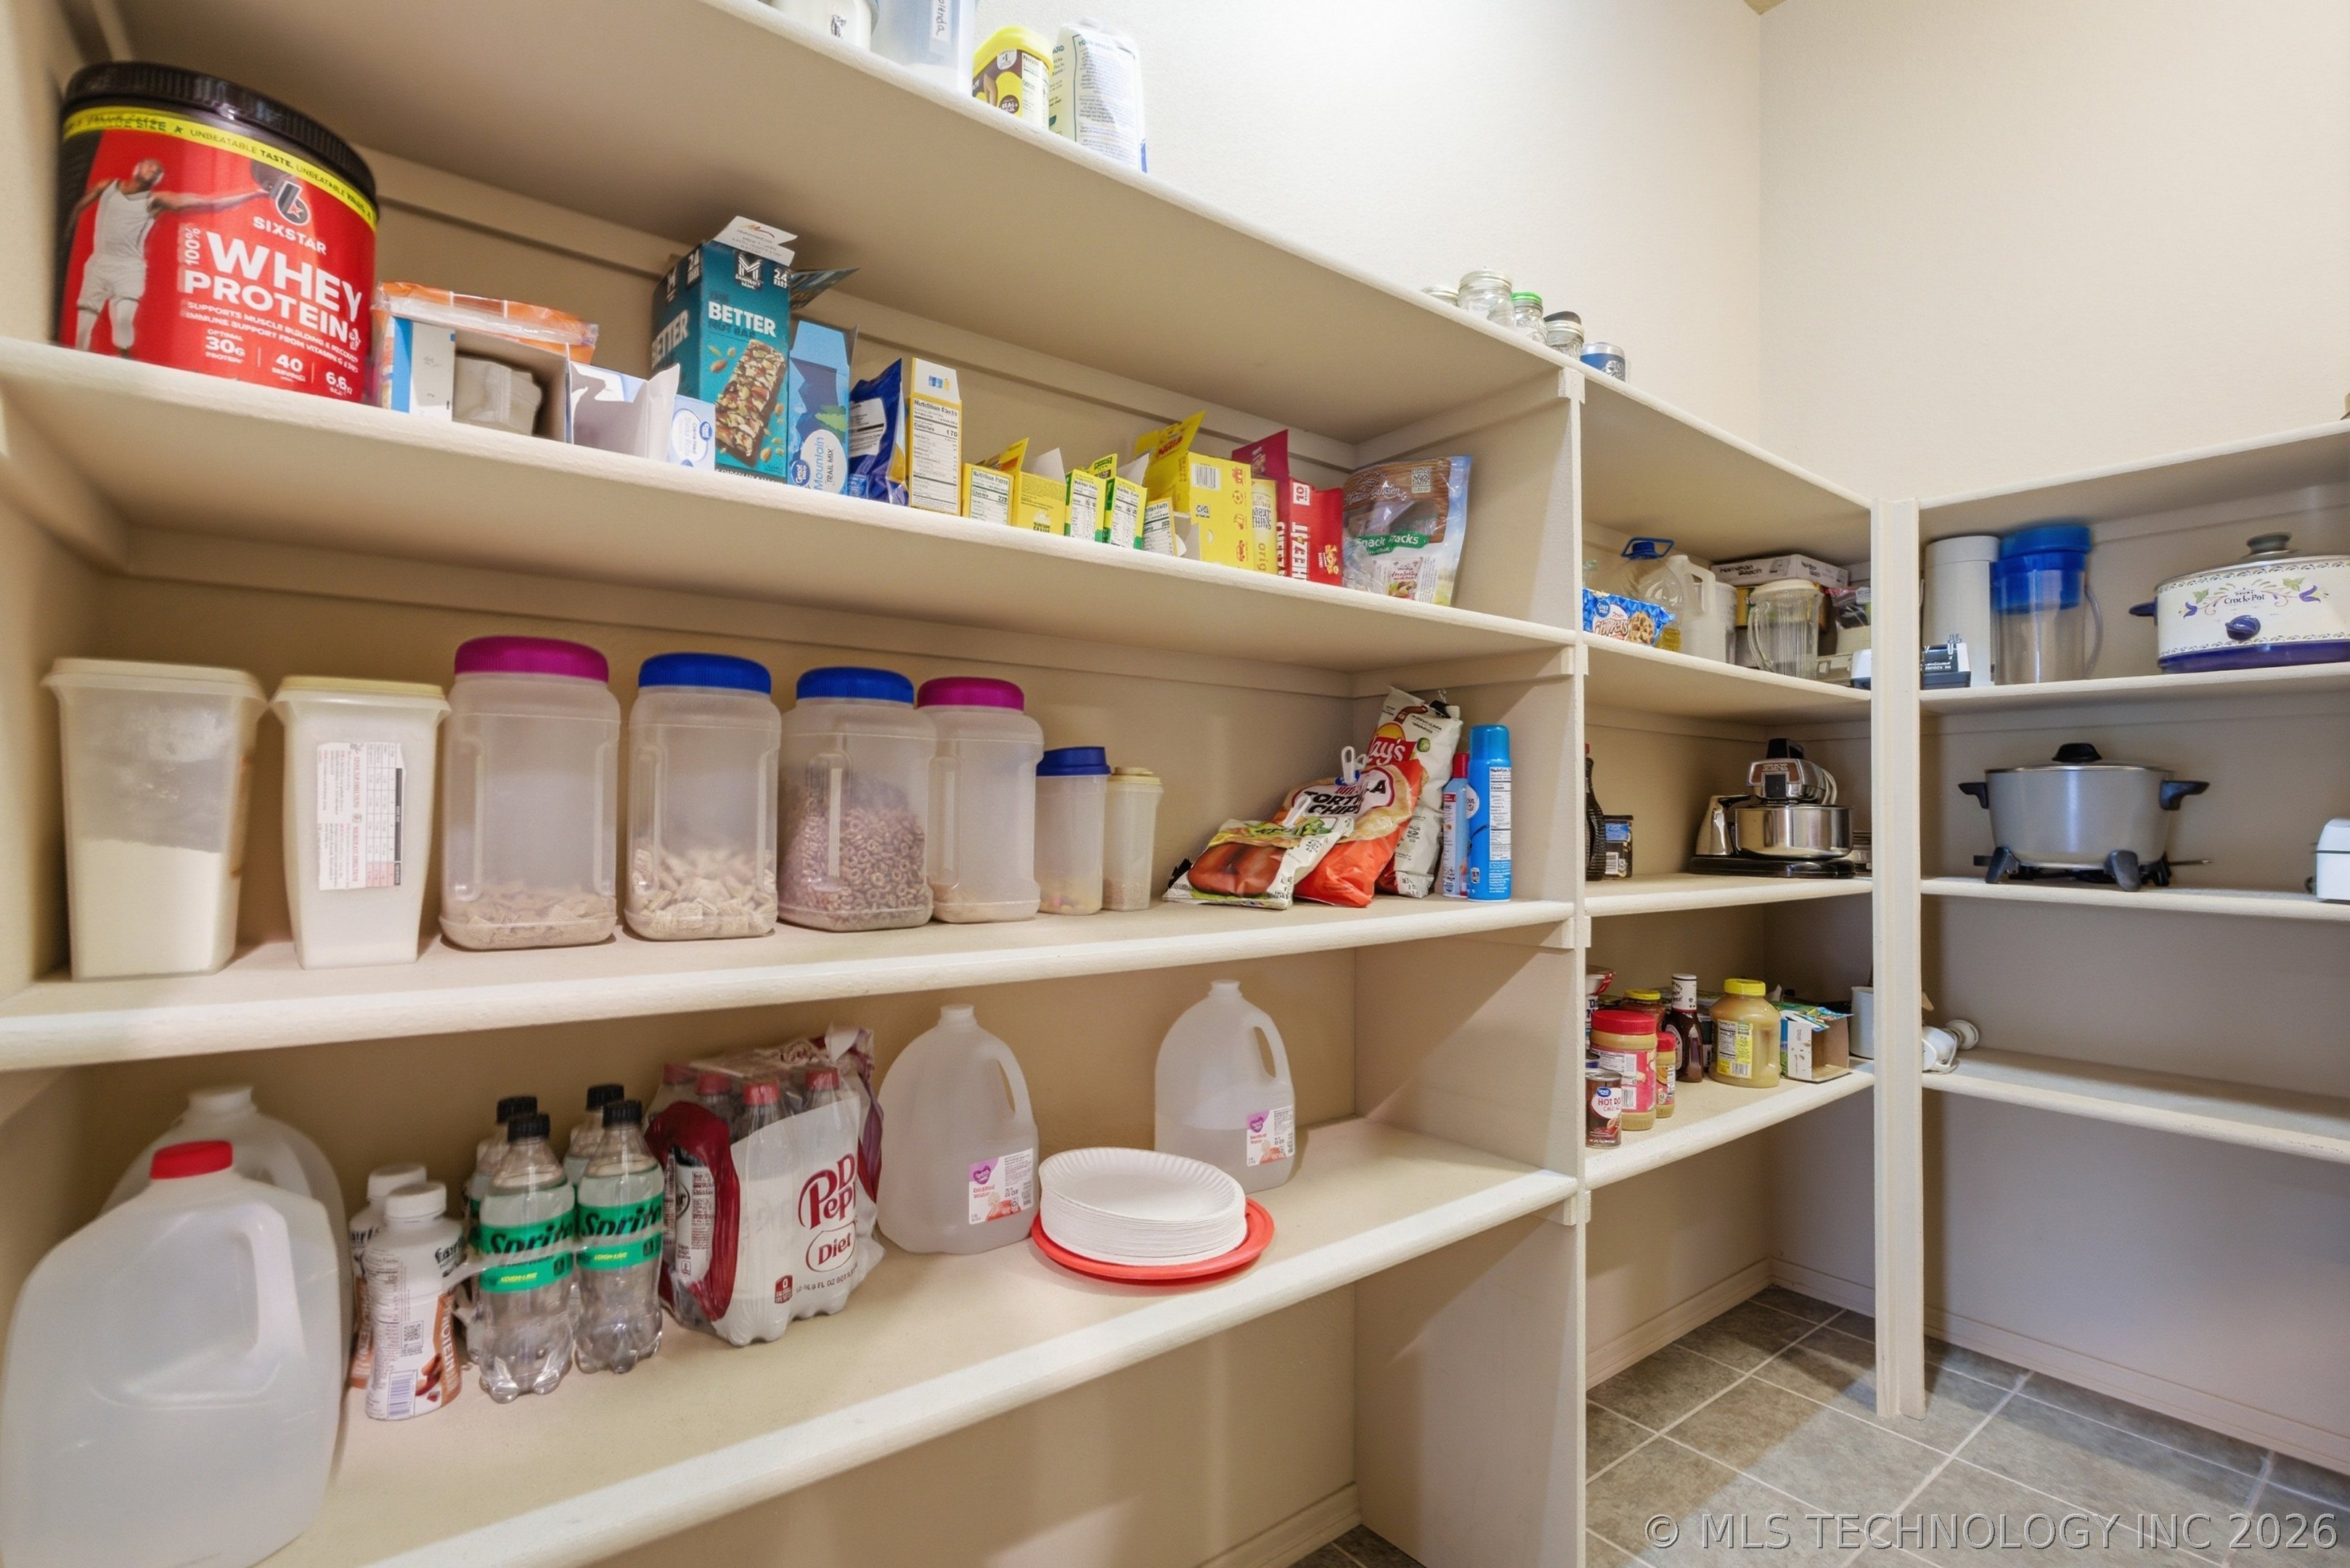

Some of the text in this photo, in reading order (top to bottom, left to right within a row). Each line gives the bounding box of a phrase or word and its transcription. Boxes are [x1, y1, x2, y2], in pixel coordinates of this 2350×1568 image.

[190, 128, 258, 154] UNBEATABLE
[184, 227, 201, 266] 100%
[253, 216, 327, 256] SIXSTAR
[205, 231, 362, 322] WHEY
[774, 267, 788, 280] 24
[184, 269, 348, 343] PROTEIN
[187, 302, 242, 319] SUPPORTS
[244, 314, 285, 330] MUSCLE
[708, 301, 777, 338] BETTER
[185, 312, 230, 327] IMMUNE
[231, 320, 277, 338] SUPPORT
[278, 334, 305, 348] FROM
[276, 354, 304, 373] 40
[814, 436, 824, 490] Mountain
[1296, 486, 1305, 501] 10
[2224, 594, 2265, 605] Crock-Pot
[799, 1169, 856, 1230] Pep
[818, 1232, 852, 1265] Diet
